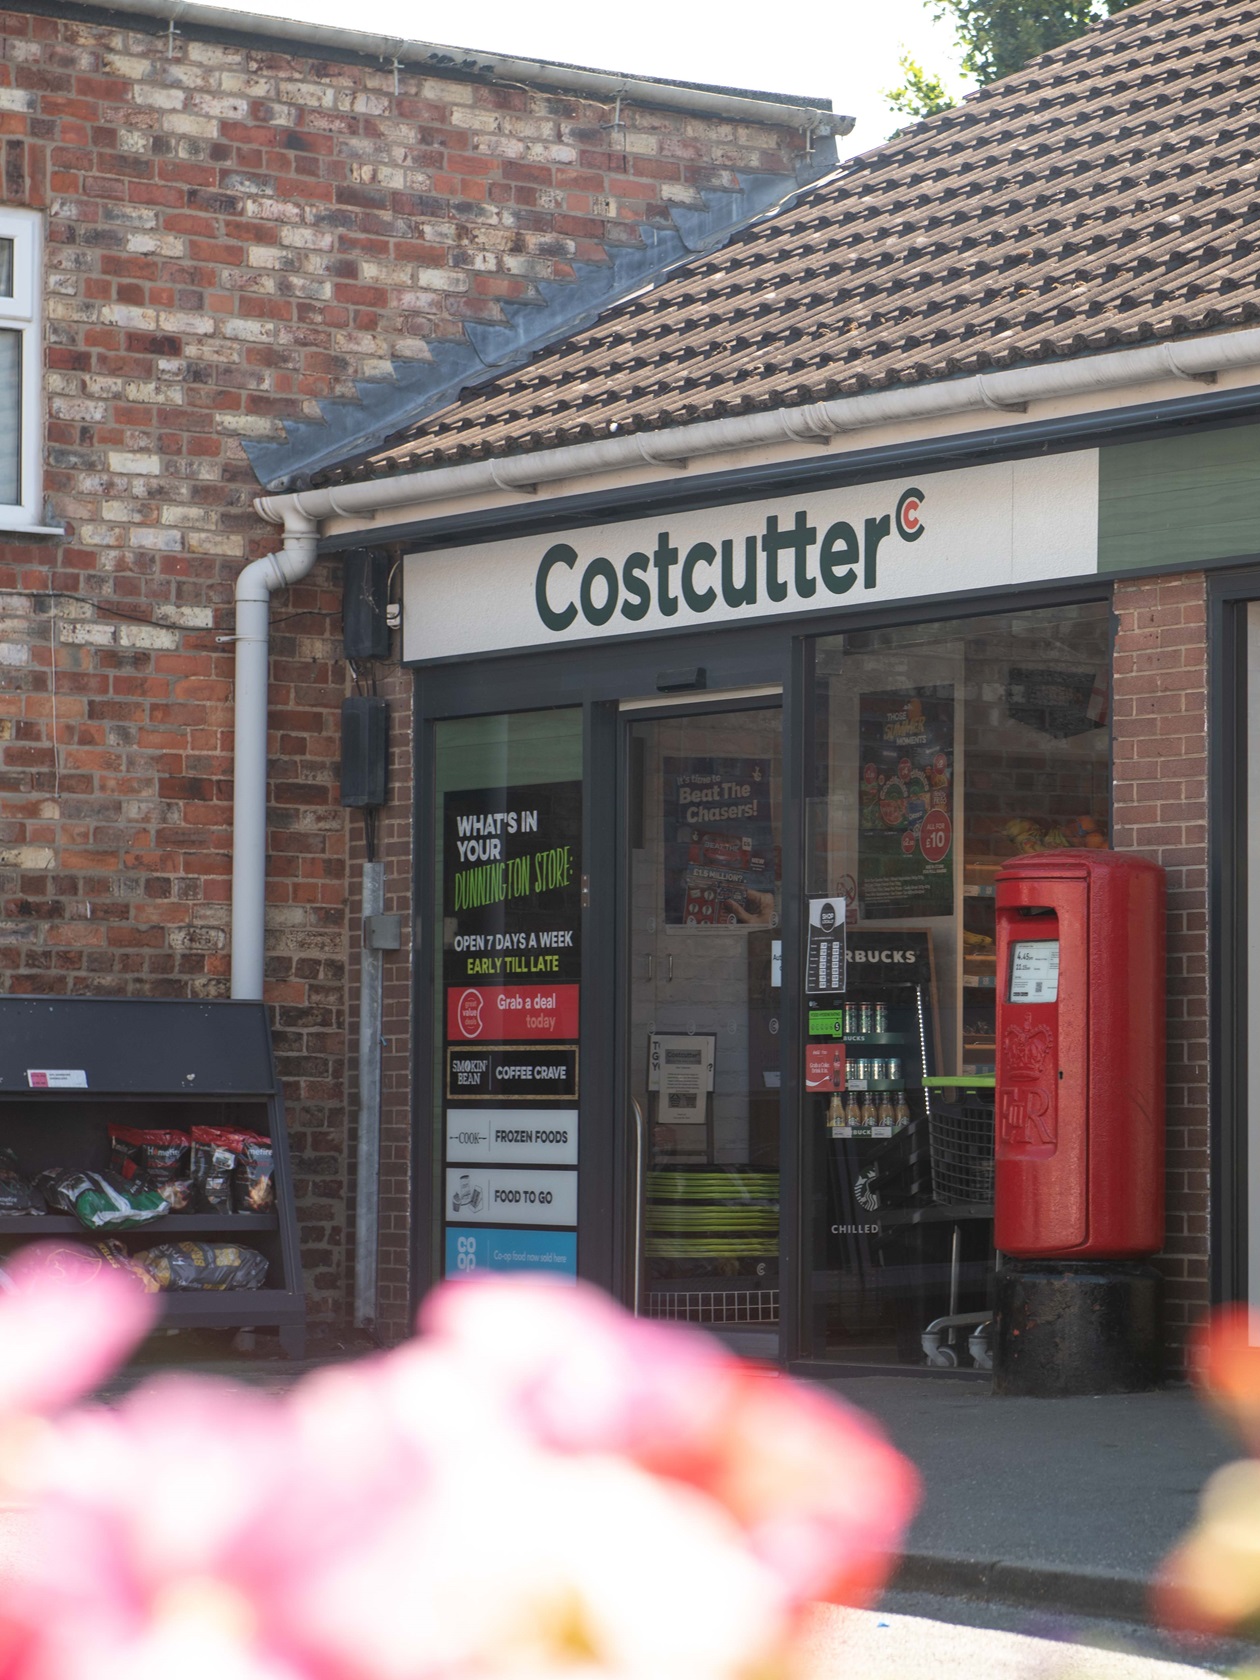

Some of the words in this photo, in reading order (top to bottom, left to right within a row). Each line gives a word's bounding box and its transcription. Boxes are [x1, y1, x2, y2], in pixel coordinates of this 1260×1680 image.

[536, 510, 890, 632] Costcutter
[887, 712, 907, 721] THOSE
[884, 717, 926, 741] SUMMER
[896, 736, 927, 746] MOMENTS
[677, 775, 690, 785] It's
[692, 774, 711, 784] time
[680, 786, 720, 804] Beat
[722, 782, 751, 799] The
[687, 800, 758, 823] Chasers!
[457, 811, 518, 837] WHAT'S
[521, 810, 538, 833] IN
[937, 822, 945, 830] FOR
[926, 831, 945, 848] £10
[457, 840, 501, 862] YOUR
[693, 868, 708, 877] £1.5
[709, 871, 743, 882] MILLION?
[455, 855, 530, 912] DUNNINGTON
[454, 934, 484, 952] OPEN
[487, 935, 494, 951] 7
[496, 933, 526, 950] DAYS
[528, 932, 537, 948] A
[539, 931, 573, 948] WEEK
[467, 957, 502, 975] EARLY
[505, 956, 528, 974] TILL
[530, 955, 559, 972] LATE
[497, 994, 523, 1010] Grab
[524, 998, 532, 1009] a
[534, 993, 556, 1009] deal
[462, 1008, 478, 1017] value
[526, 1014, 556, 1032] today
[452, 1060, 488, 1073] SMOKIN'
[496, 1066, 532, 1080] COFFEE
[534, 1065, 567, 1080] CRAVE
[458, 1073, 481, 1085] BEAN
[458, 1132, 480, 1145] COOK
[495, 1130, 532, 1144] FROZEN
[535, 1130, 568, 1144] FOODS
[494, 1190, 521, 1204] FOOD
[523, 1190, 536, 1204] TO
[538, 1191, 553, 1205] GO
[831, 1224, 879, 1235] CHILLED
[494, 1250, 512, 1262] Co-op
[513, 1251, 526, 1262] food
[526, 1254, 540, 1262] now
[552, 1253, 567, 1264] here
